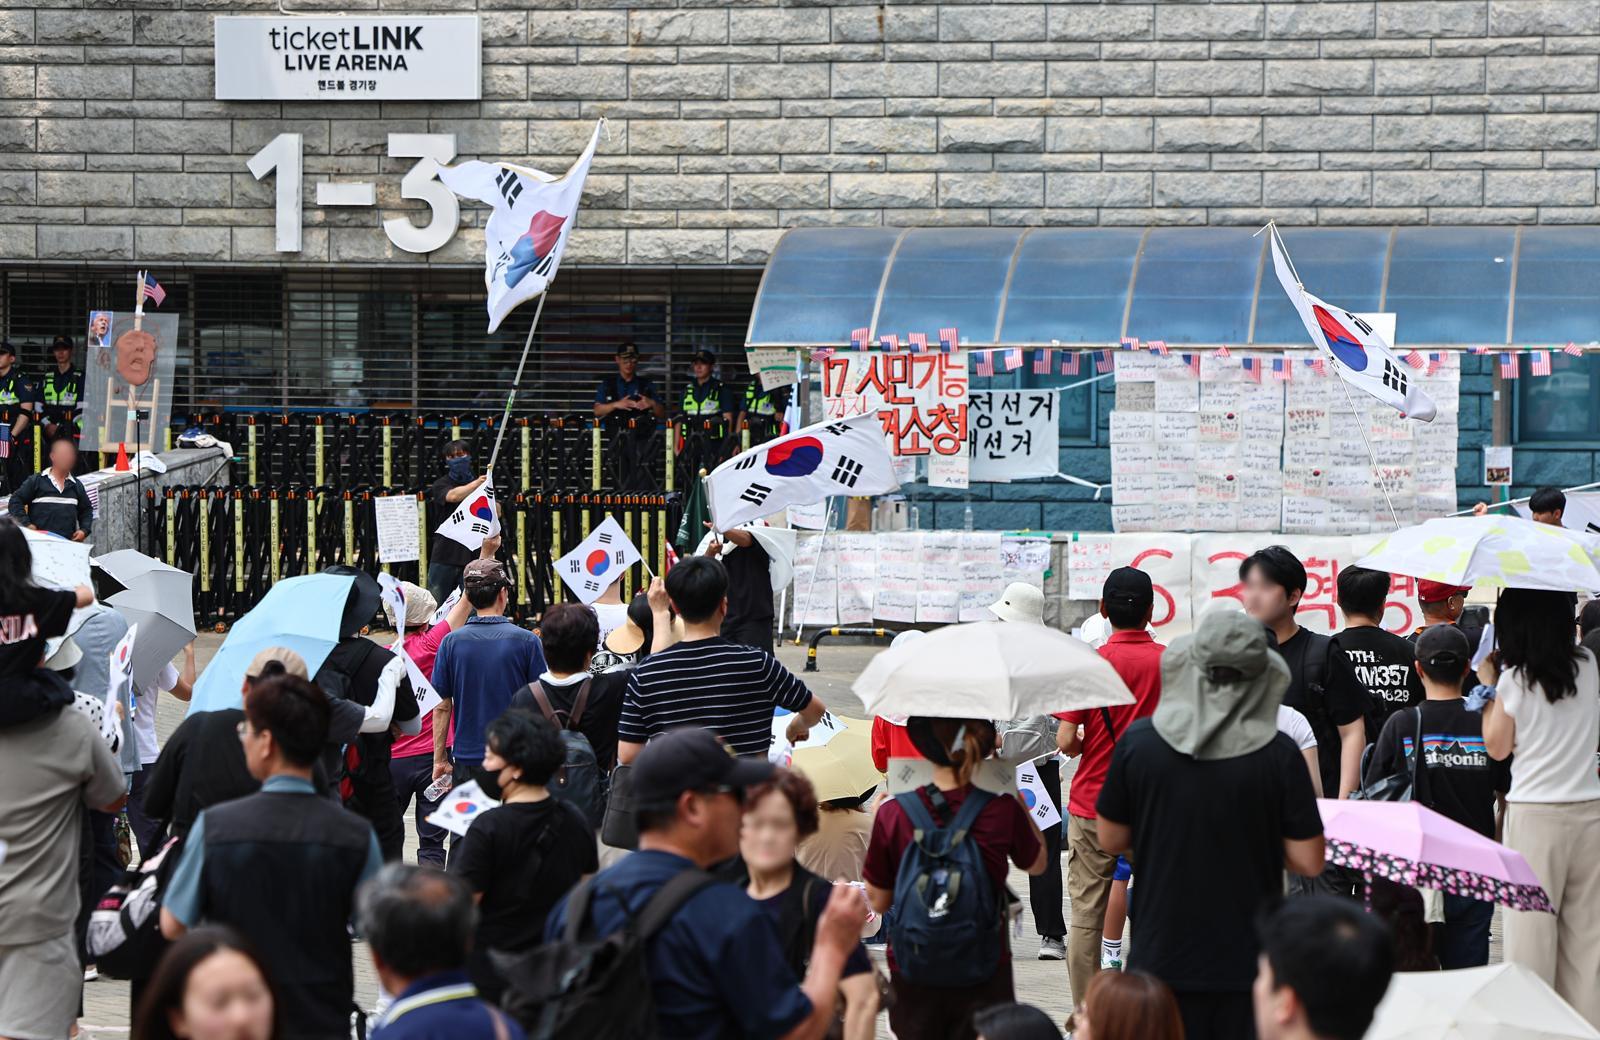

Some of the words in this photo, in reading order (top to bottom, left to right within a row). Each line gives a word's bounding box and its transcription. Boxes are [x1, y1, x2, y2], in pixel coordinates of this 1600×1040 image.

[269, 26, 424, 51] ticketLINK
[284, 54, 331, 71] LIVE
[335, 54, 408, 71] ARENA
[318, 80, 345, 91] 핸드볼
[349, 80, 377, 91] 경기장
[246, 133, 460, 253] 1-3
[1411, 751, 1487, 768] atagonia
